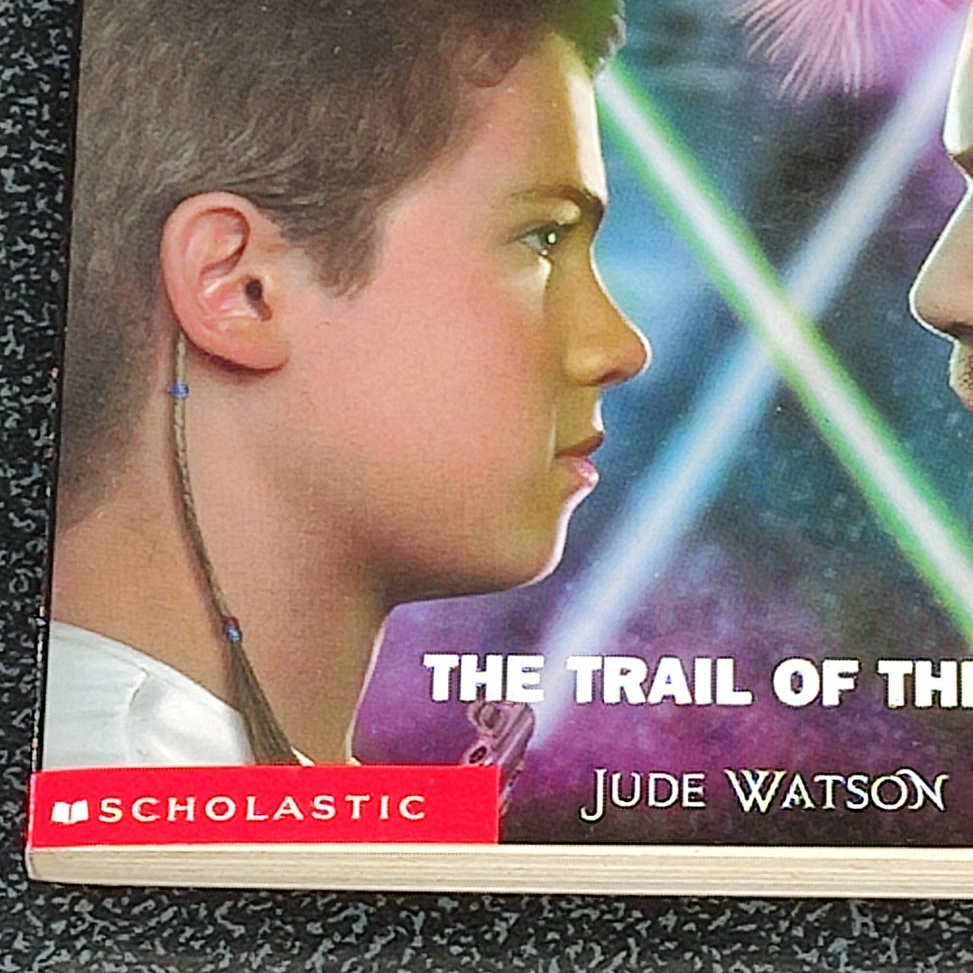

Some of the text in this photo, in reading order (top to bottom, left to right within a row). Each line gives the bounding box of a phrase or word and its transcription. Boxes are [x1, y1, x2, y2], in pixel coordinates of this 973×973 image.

[423, 653, 545, 702] THE
[566, 655, 753, 706] TRAIL
[772, 658, 860, 708] OF
[98, 794, 428, 824] SCHOLASTIC
[580, 767, 950, 821] JUDE WATSON
